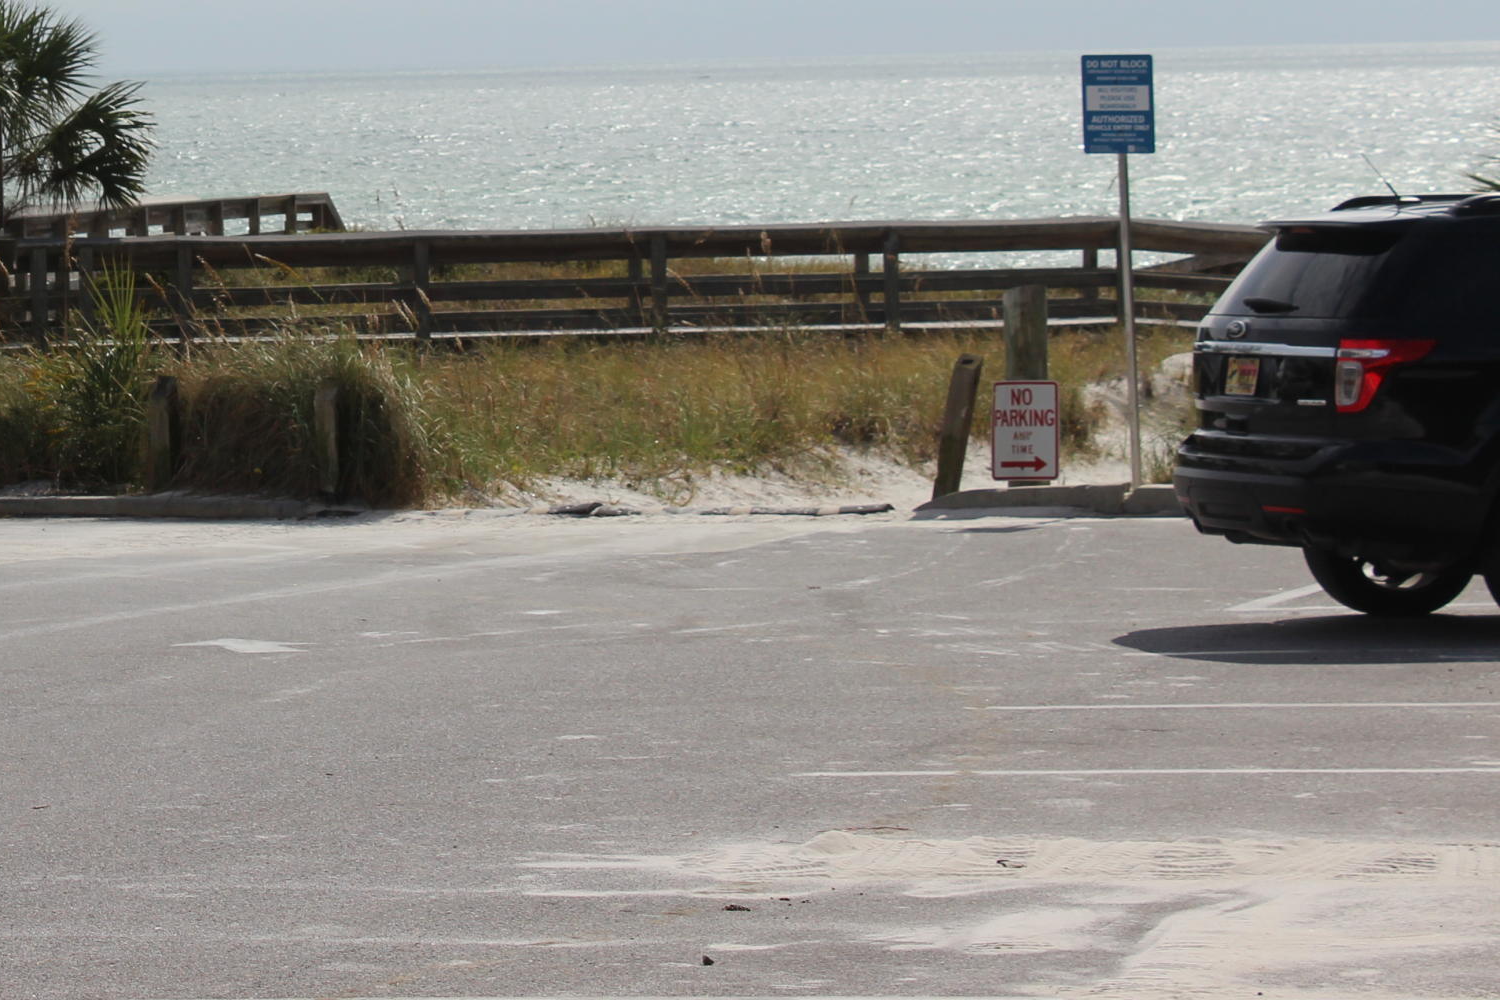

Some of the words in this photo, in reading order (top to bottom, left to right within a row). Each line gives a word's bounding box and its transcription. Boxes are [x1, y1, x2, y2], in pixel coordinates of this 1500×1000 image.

[1086, 60, 1099, 68] DO
[1101, 60, 1118, 68] NOT
[1120, 60, 1148, 68] BLOCK
[1091, 115, 1145, 123] AUTHORIZED
[1010, 388, 1033, 406] NO
[994, 409, 1056, 427] PARKING
[1013, 431, 1033, 440] ANY
[1011, 444, 1035, 454] TIME
